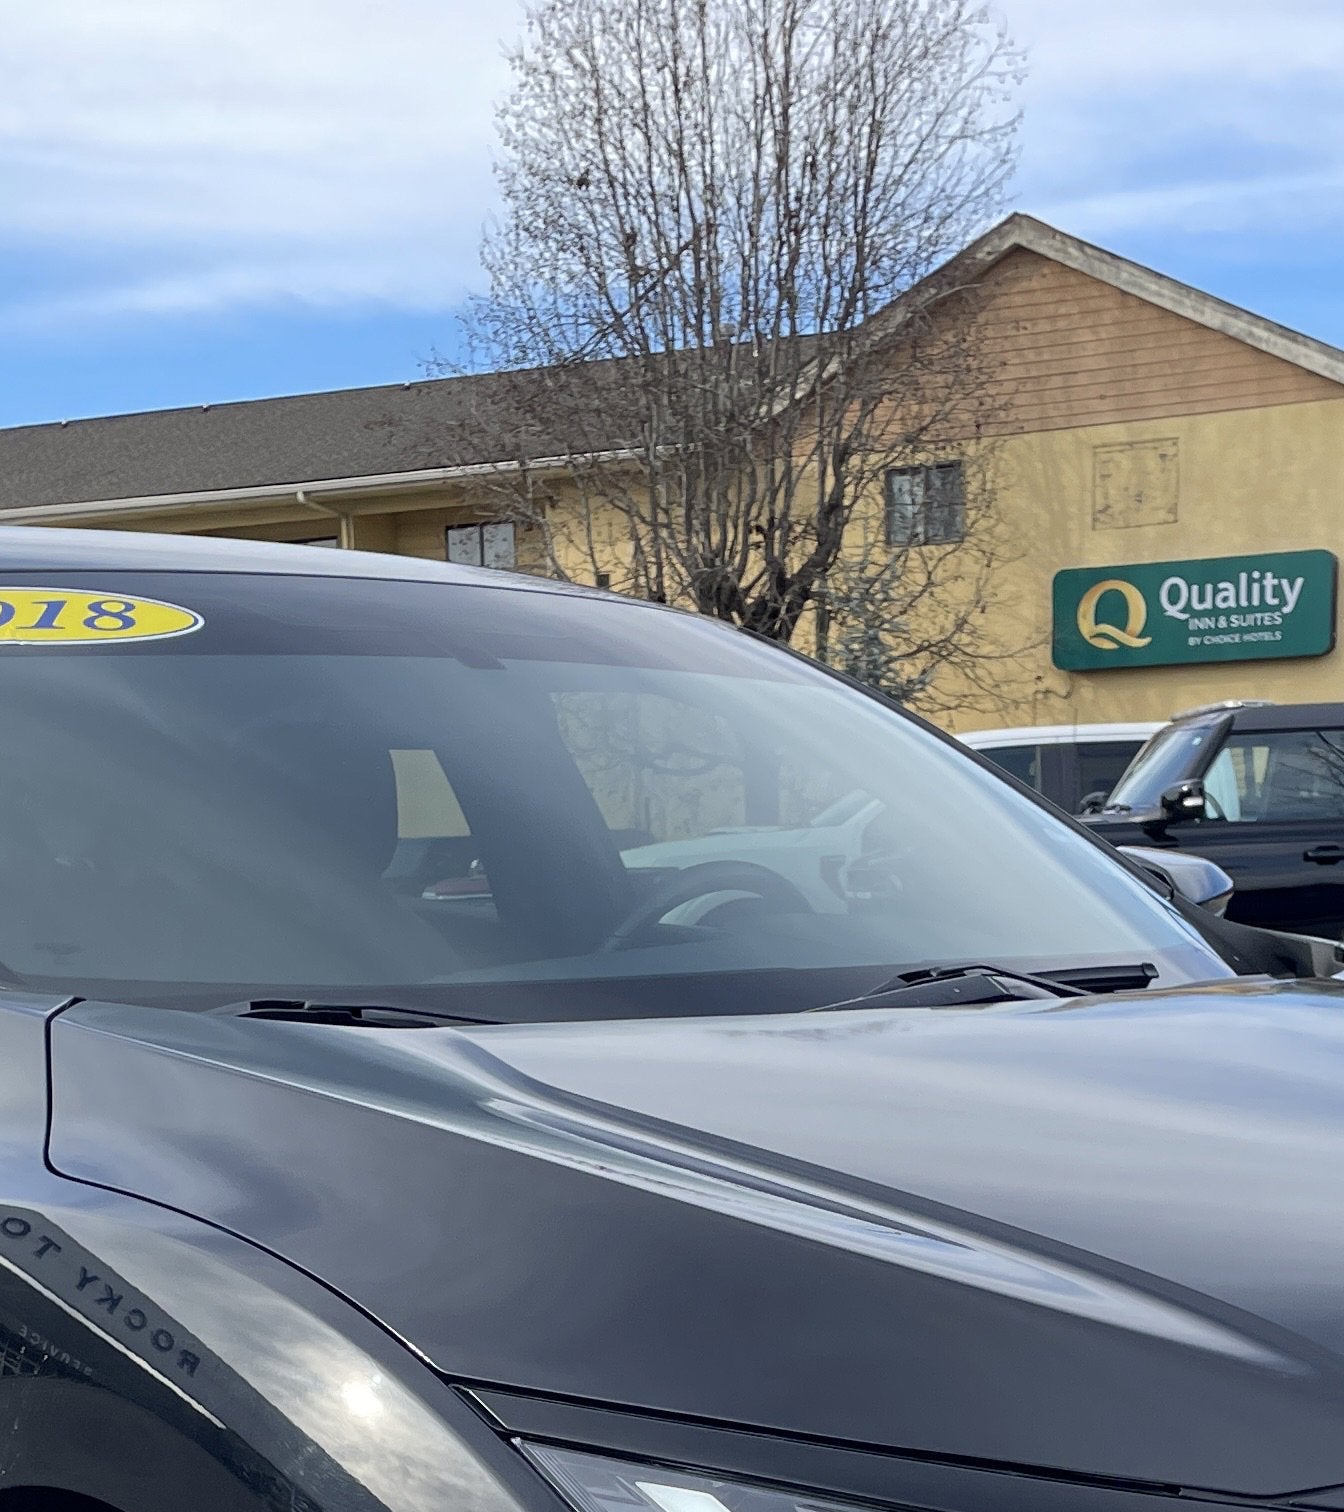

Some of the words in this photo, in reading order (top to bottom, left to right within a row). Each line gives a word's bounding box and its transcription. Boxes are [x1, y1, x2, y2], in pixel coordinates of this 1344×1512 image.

[1159, 570, 1305, 620] Quality
[1077, 579, 1153, 650] Q
[1188, 616, 1216, 631] INN
[1217, 615, 1228, 629] &
[1229, 611, 1283, 628] SUITES
[1188, 636, 1202, 647] BY
[1203, 633, 1241, 645] CHOICE
[1242, 630, 1283, 643] HOTELS
